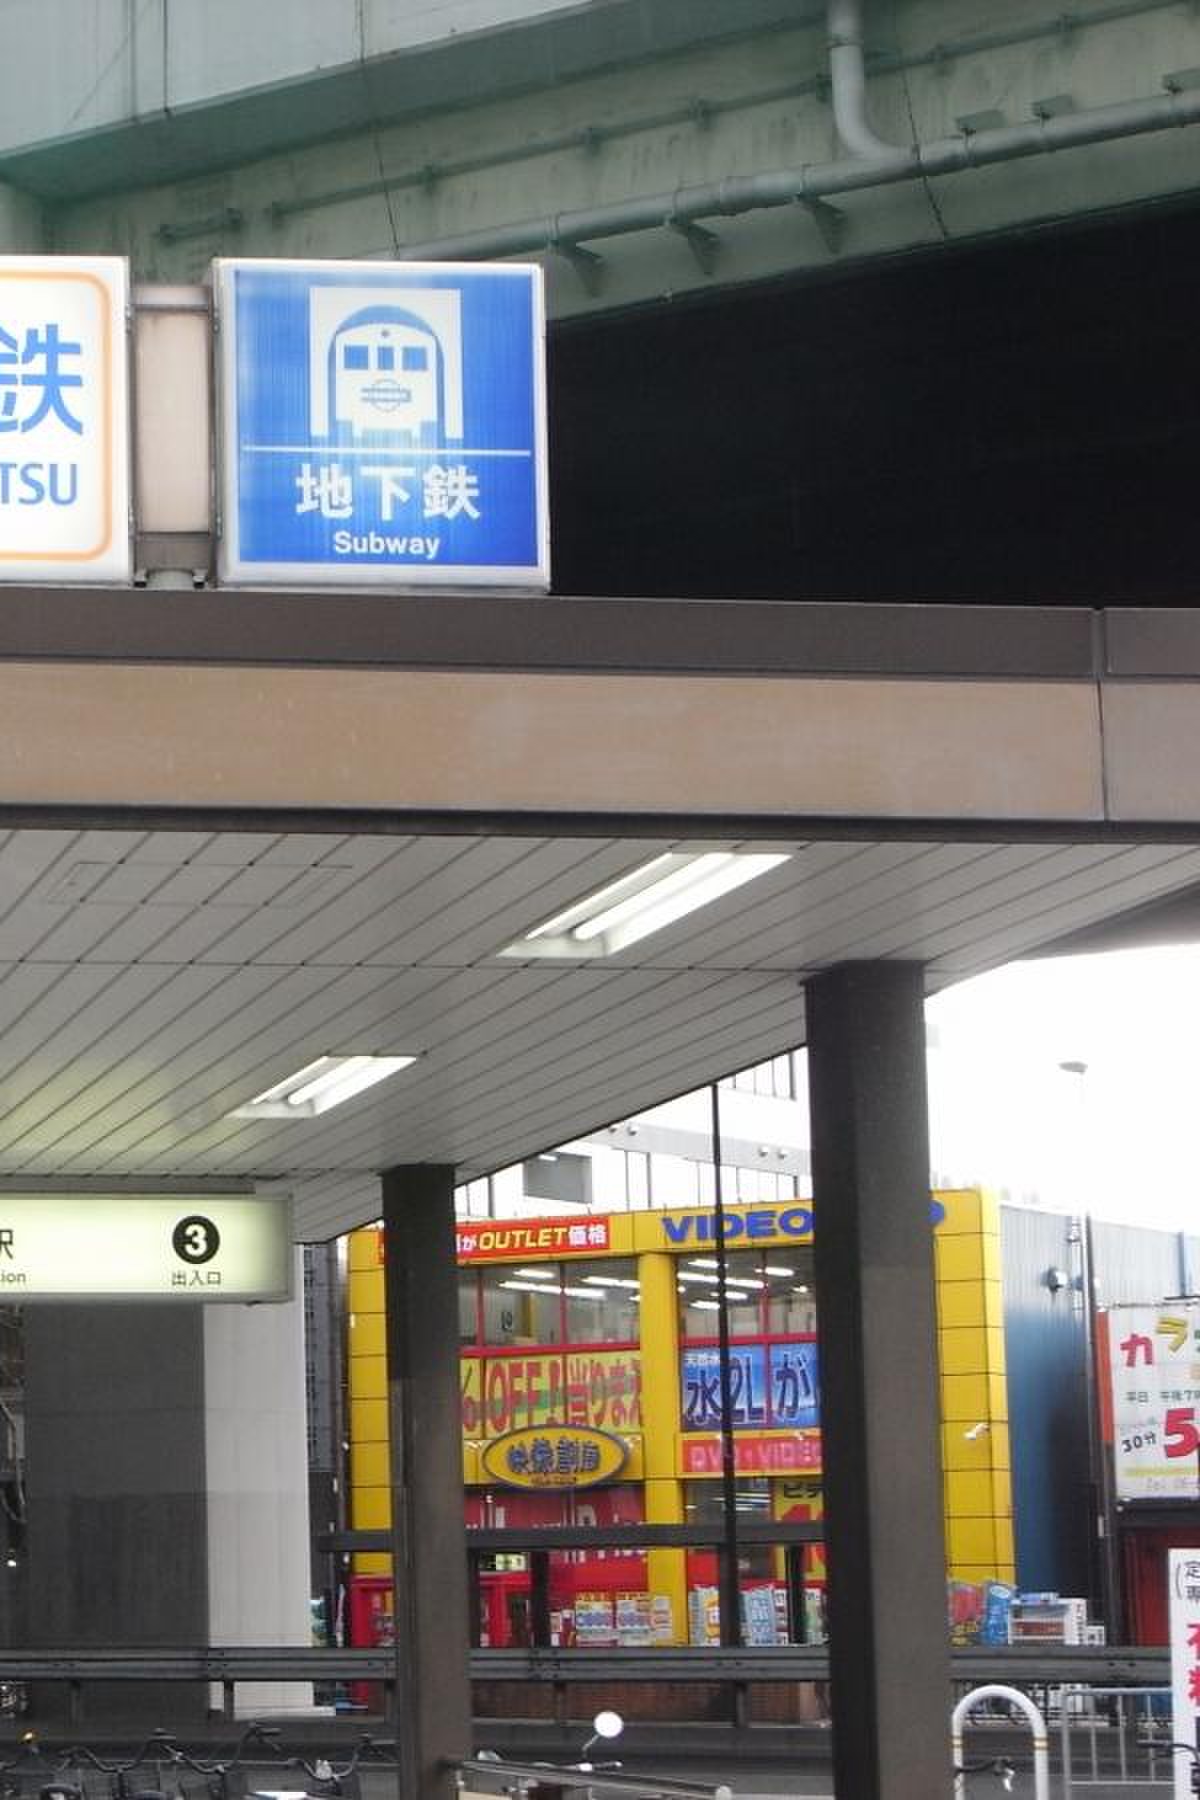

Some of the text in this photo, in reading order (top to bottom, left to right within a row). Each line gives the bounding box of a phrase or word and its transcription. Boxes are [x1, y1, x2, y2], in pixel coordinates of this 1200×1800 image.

[295, 463, 482, 520] 地下鉄
[333, 531, 441, 561] Subway
[661, 1208, 814, 1242] VIDEO
[171, 1271, 222, 1286] 出入口
